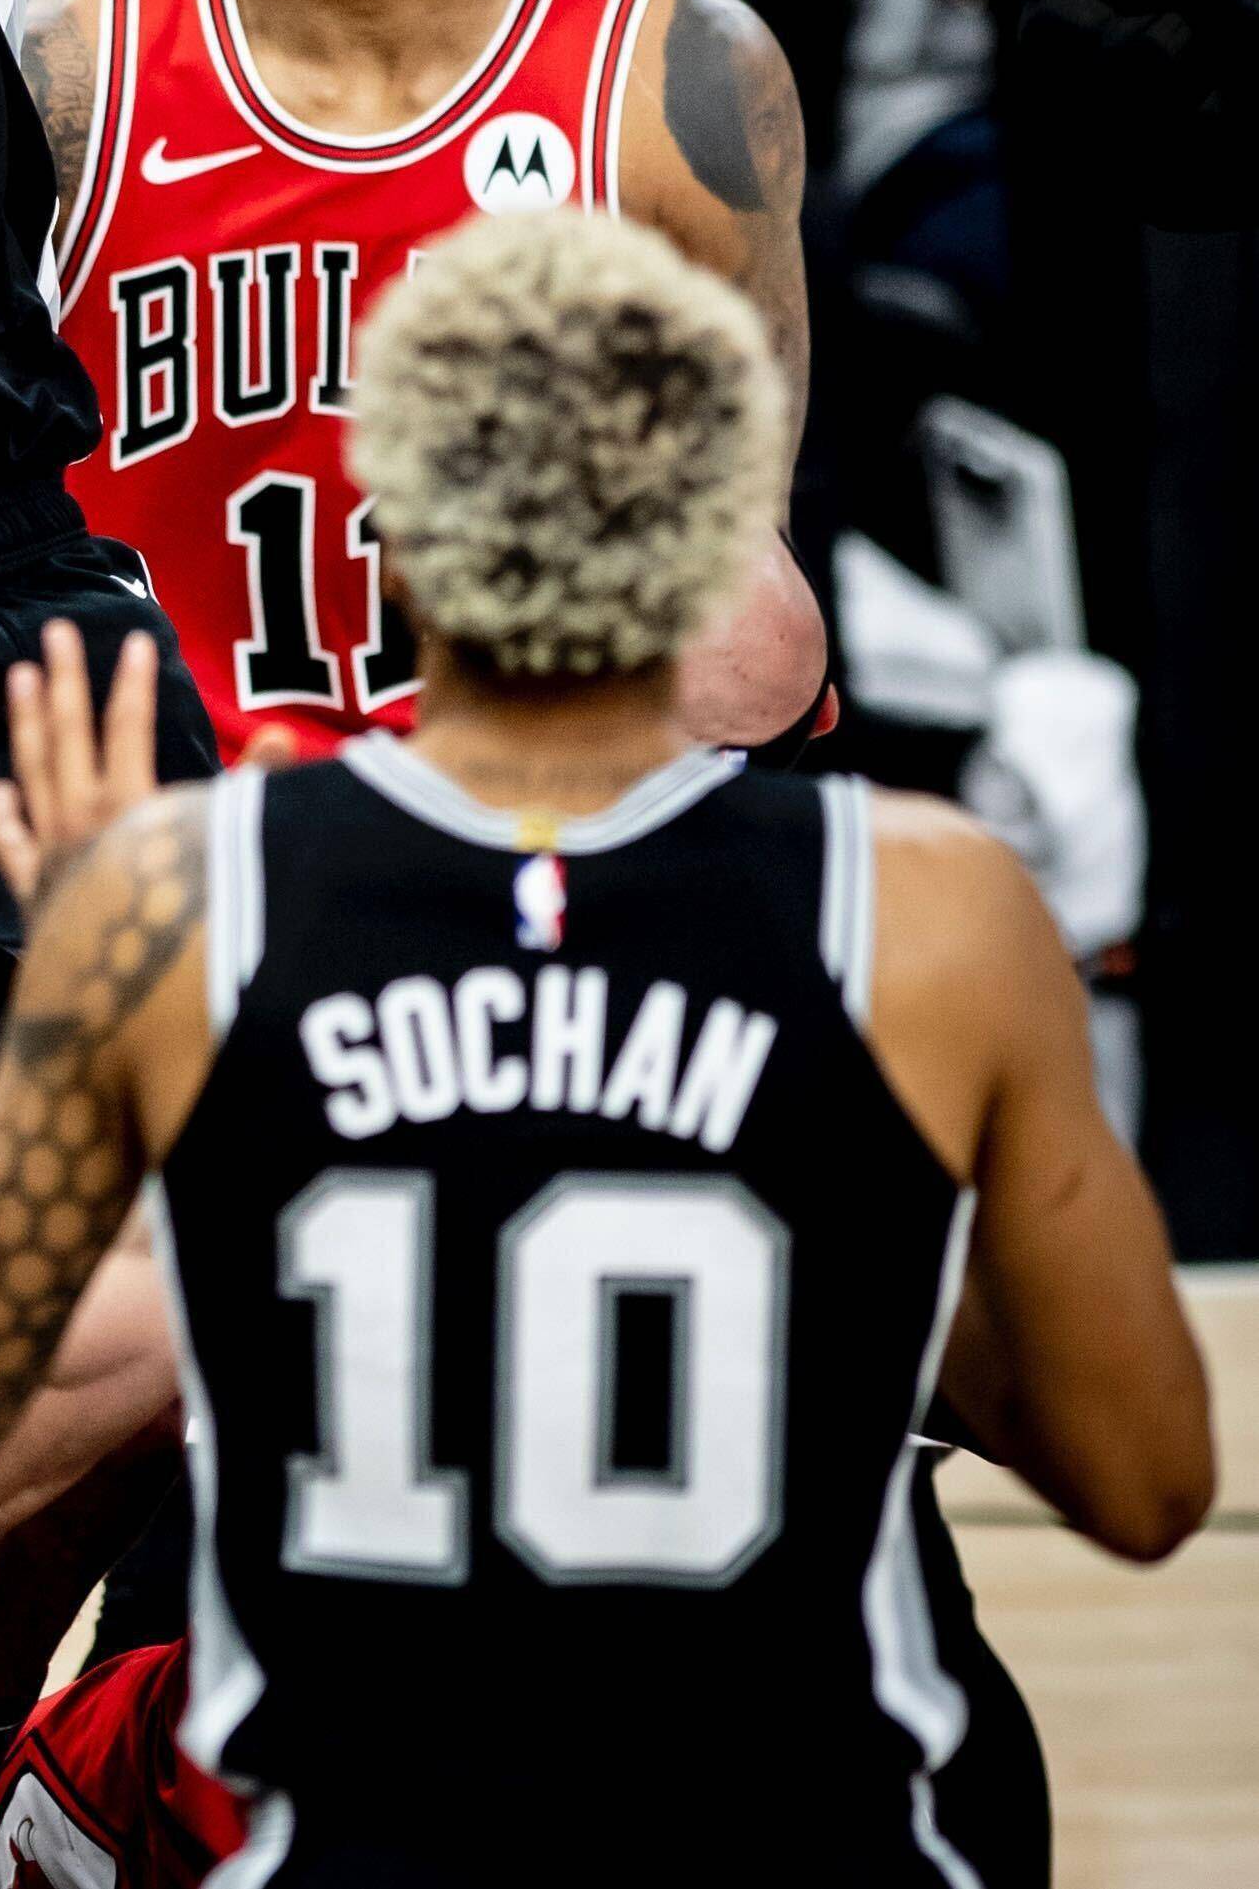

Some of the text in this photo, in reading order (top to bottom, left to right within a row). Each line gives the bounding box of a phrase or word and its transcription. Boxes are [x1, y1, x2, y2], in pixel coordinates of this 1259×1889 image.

[110, 242, 431, 471] BUL
[298, 965, 779, 1154] SOCHAN
[275, 1166, 793, 1590] 10
